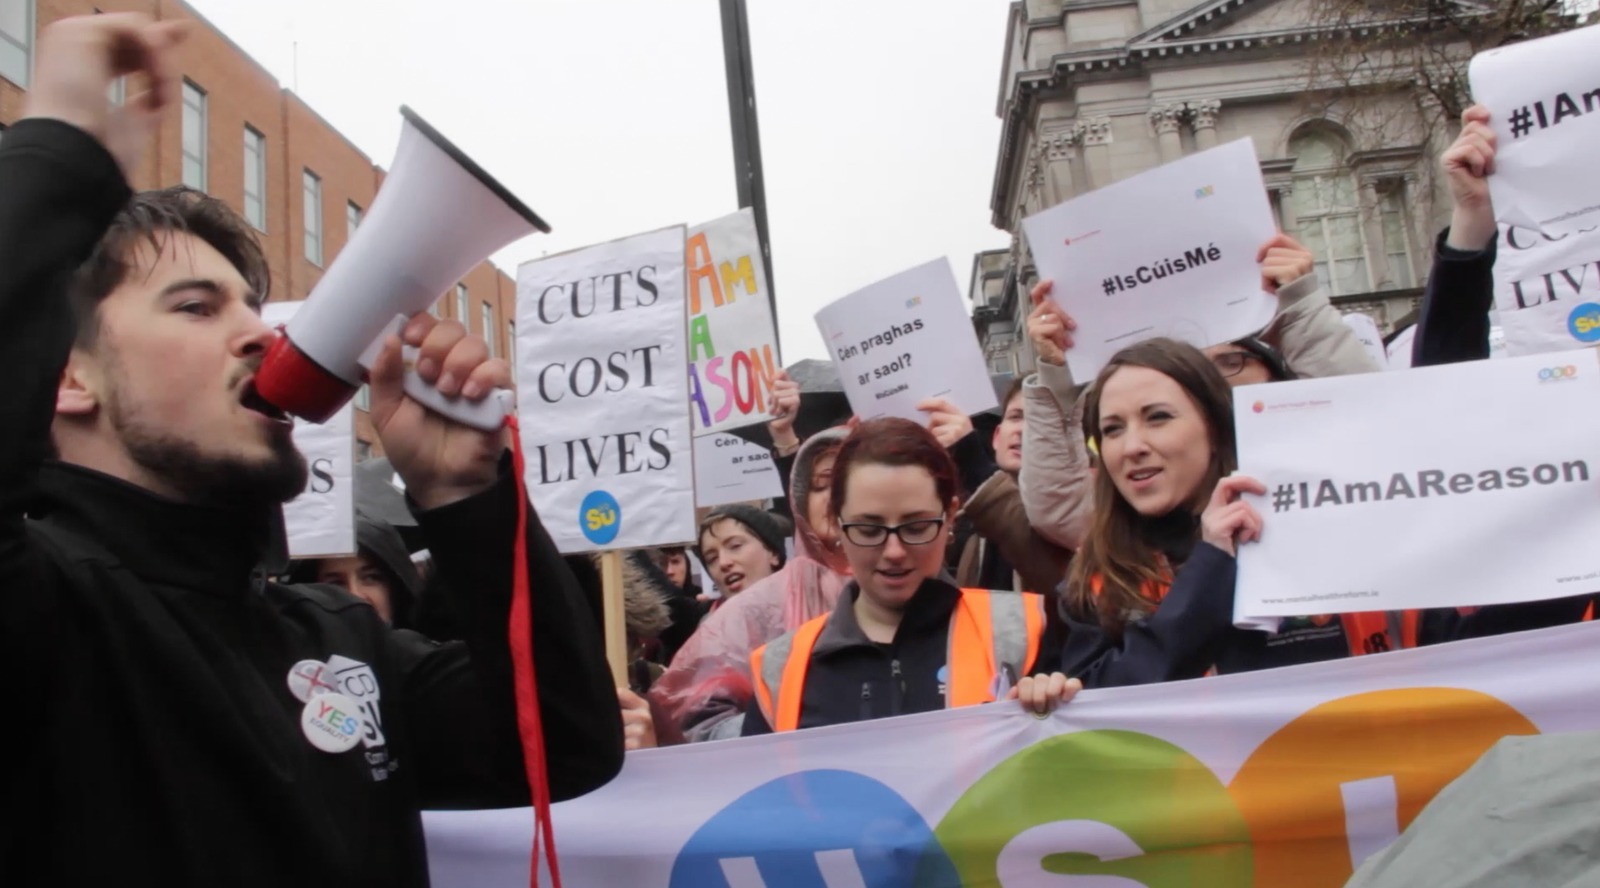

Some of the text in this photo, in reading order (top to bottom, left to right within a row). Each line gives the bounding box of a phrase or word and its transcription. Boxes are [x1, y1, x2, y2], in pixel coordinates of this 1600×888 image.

[1101, 242, 1222, 296] #IsCúisMé
[537, 265, 659, 325] CUTS
[690, 313, 716, 362] A
[860, 318, 924, 356] praghas
[537, 345, 661, 403] COST
[858, 352, 913, 386] ar saol?
[537, 428, 671, 485] LIVES
[732, 456, 744, 464] ar
[1272, 459, 1590, 513] #IAmAReason
[586, 508, 616, 530] SU
[318, 700, 359, 736] YES
